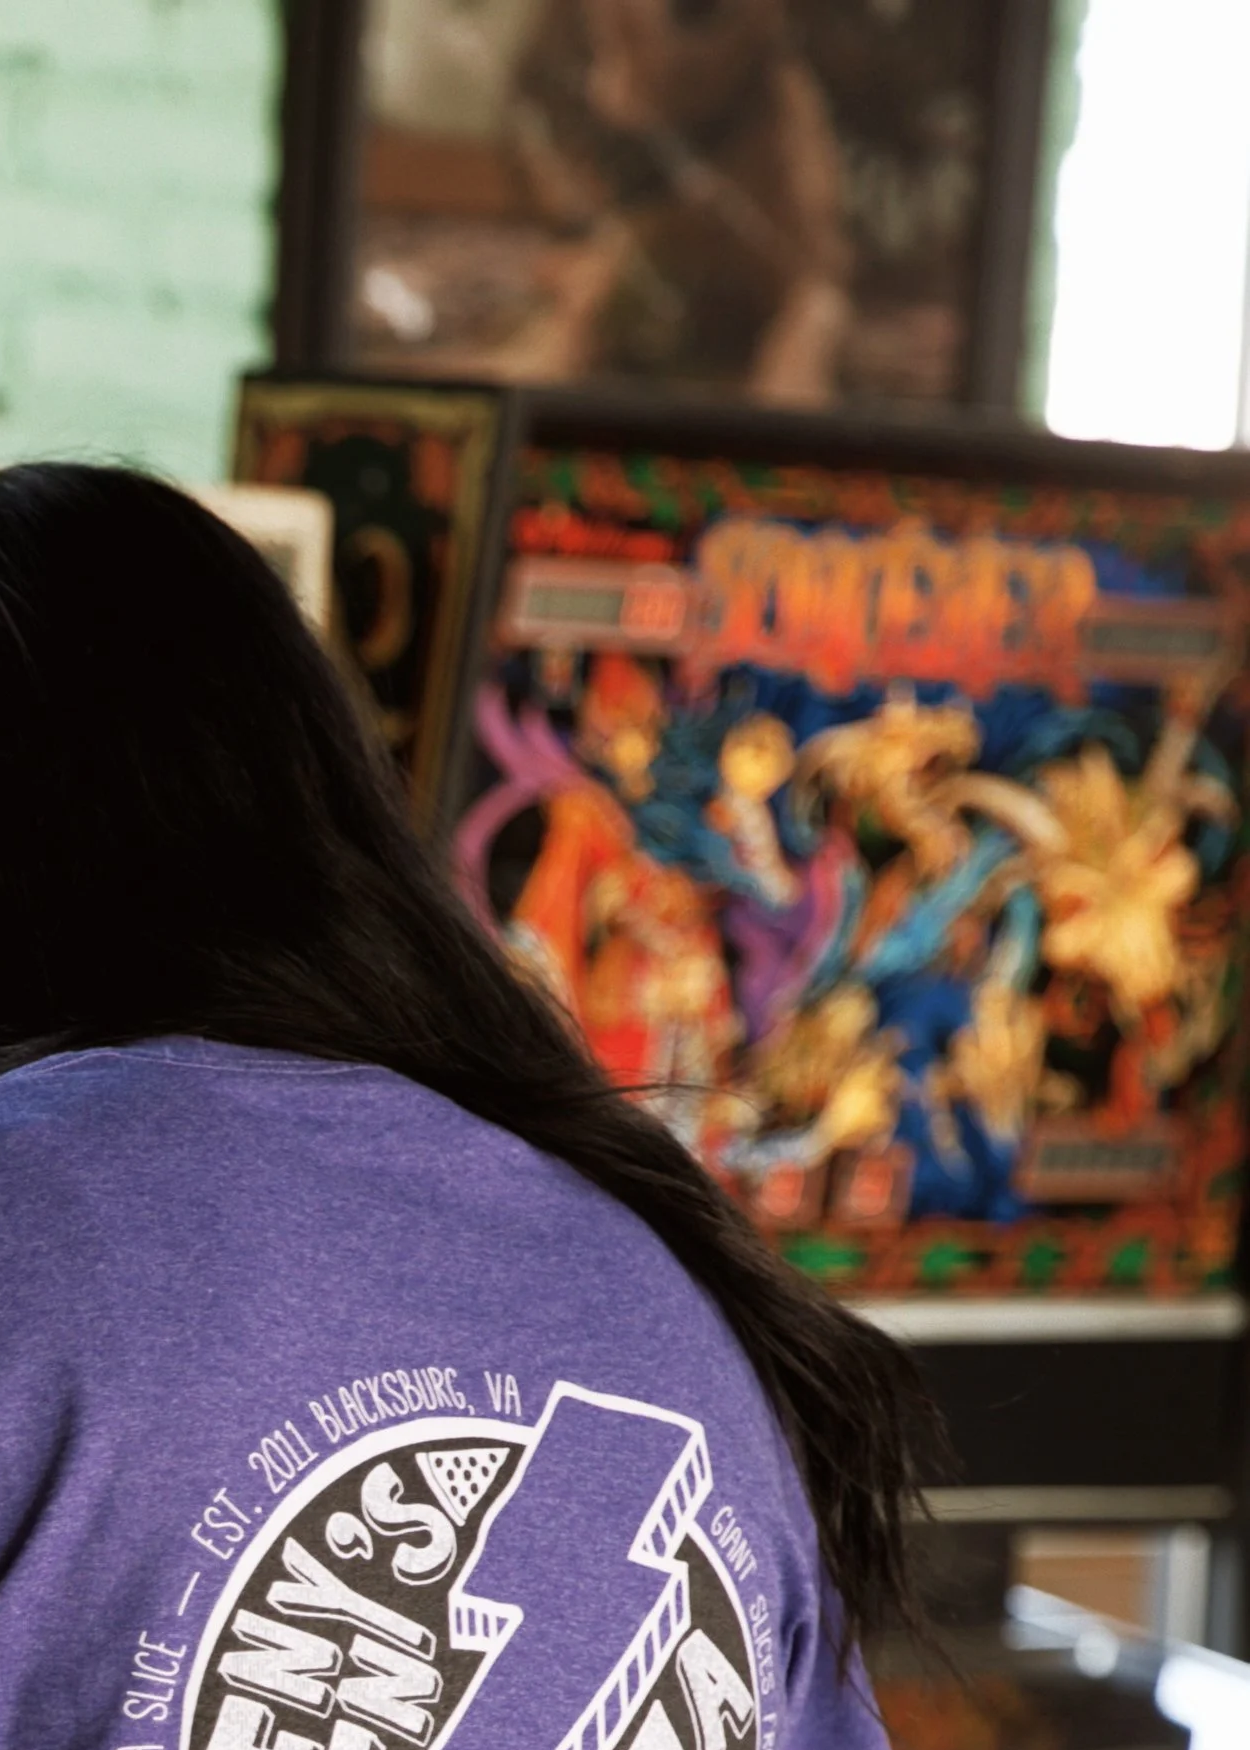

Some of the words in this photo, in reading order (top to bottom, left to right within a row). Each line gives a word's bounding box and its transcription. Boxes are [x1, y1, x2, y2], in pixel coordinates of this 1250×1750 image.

[122, 1630, 188, 1722] SLICE
[190, 1487, 263, 1561] EST.
[247, 1419, 320, 1495] 2011
[308, 1365, 477, 1444] BLACKSBURG,
[483, 1370, 523, 1418] VA
[710, 1504, 758, 1582] GIANT
[749, 1593, 777, 1696] SLICES
